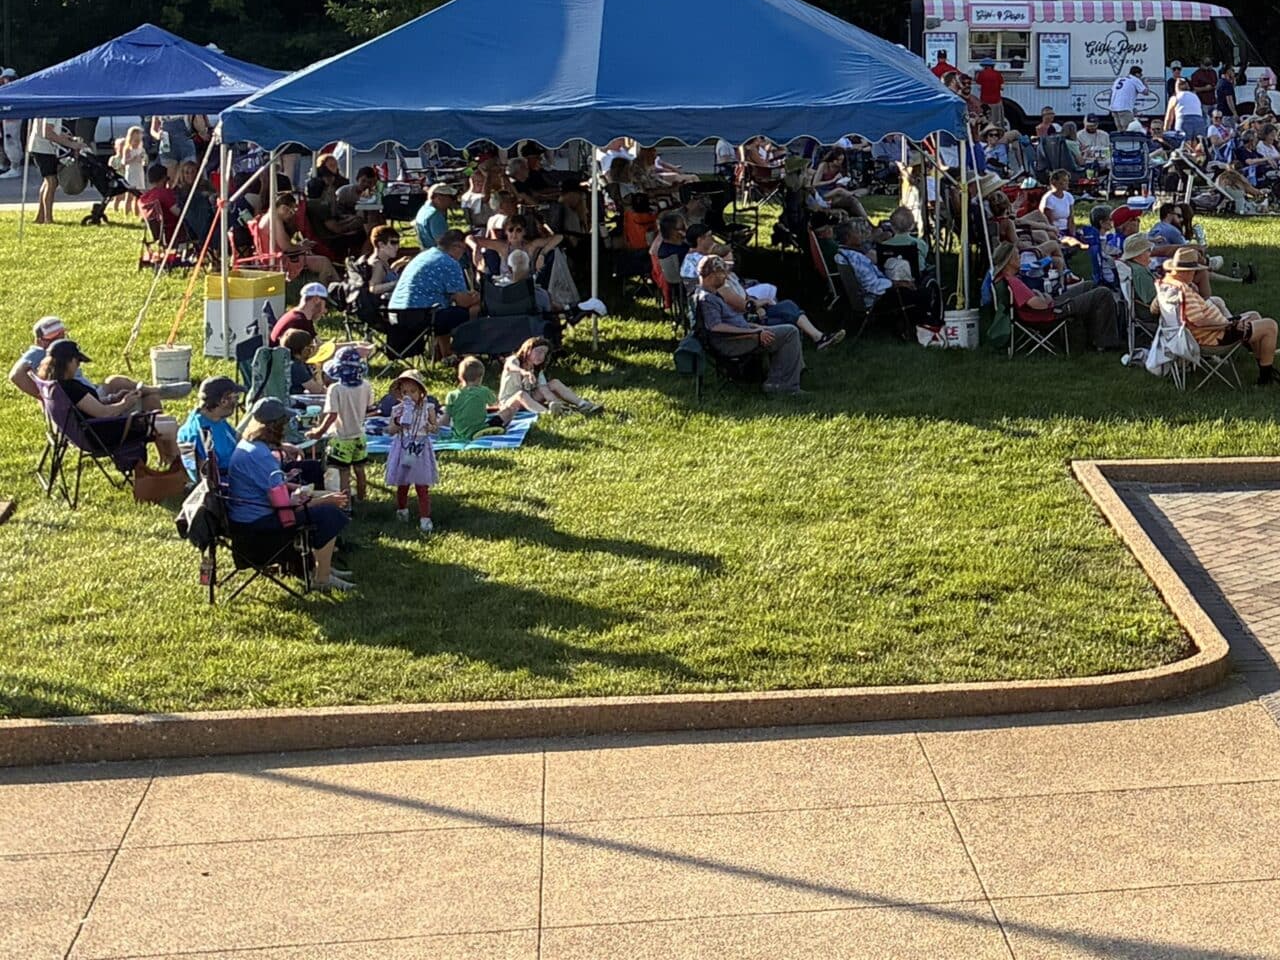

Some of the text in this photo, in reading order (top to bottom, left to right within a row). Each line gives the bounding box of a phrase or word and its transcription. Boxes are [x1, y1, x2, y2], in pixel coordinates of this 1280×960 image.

[1084, 39, 1149, 58] Gigi Pops
[1116, 79, 1126, 90] 5
